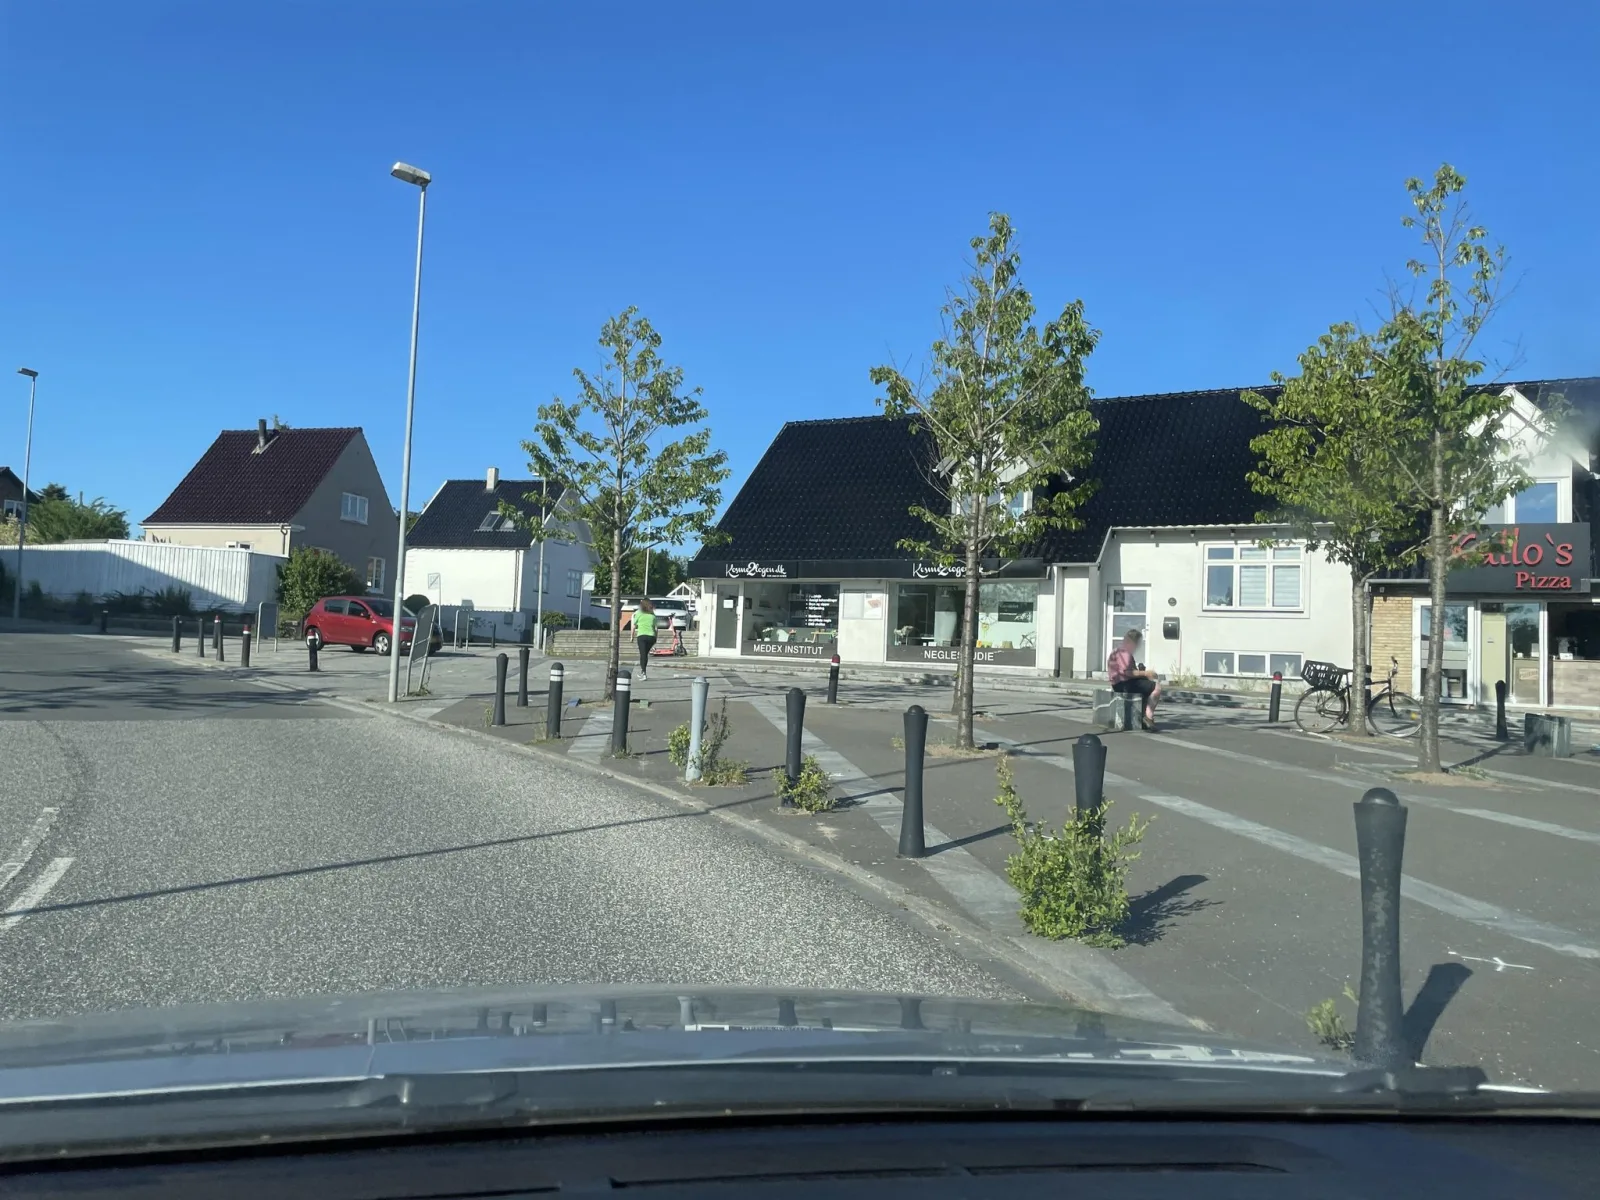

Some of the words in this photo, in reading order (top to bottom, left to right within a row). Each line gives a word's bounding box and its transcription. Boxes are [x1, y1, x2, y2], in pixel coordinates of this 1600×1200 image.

[1515, 571, 1572, 588] Pizza
[753, 644, 782, 653] MEDEX
[784, 645, 823, 655] INSTITUT
